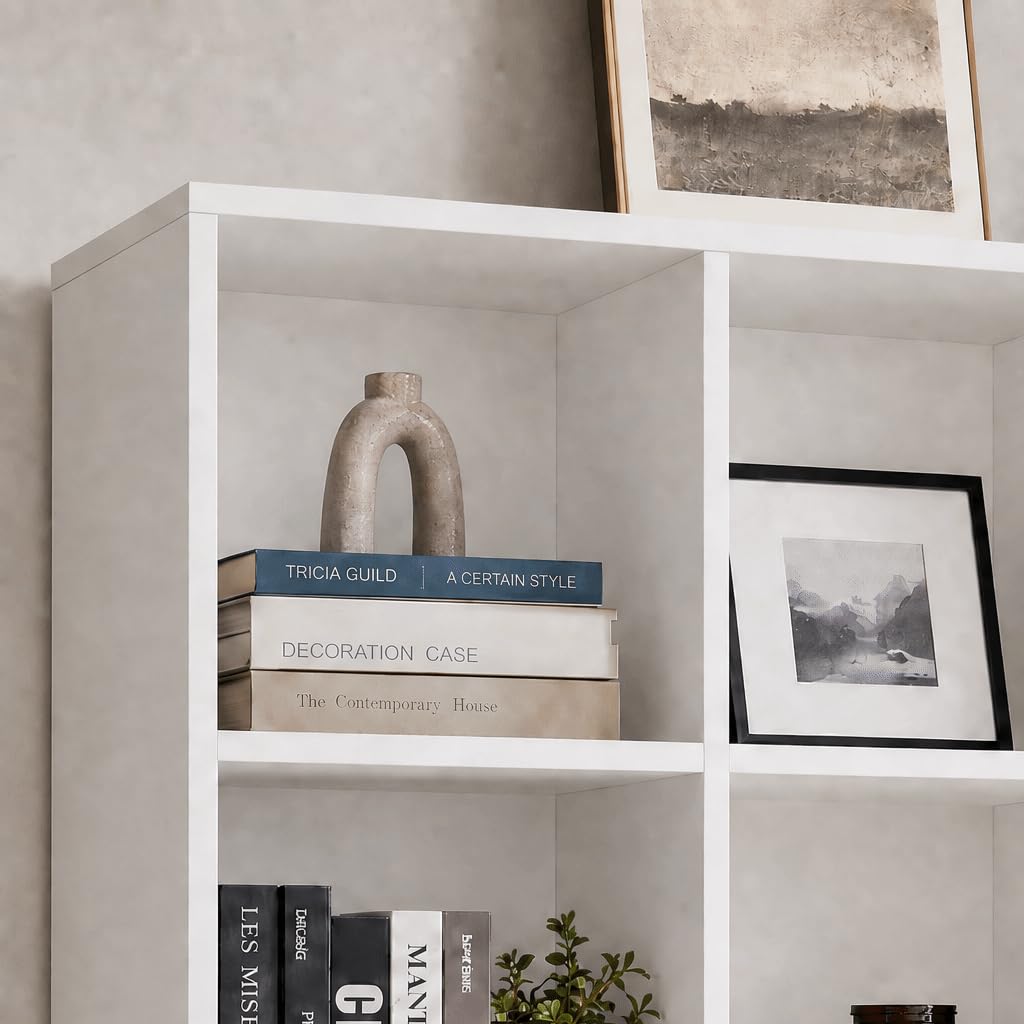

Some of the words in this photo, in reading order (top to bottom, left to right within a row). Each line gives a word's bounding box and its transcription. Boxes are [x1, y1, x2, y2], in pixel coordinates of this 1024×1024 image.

[285, 564, 341, 581] TRICIA
[346, 567, 397, 583] GUILD
[446, 571, 457, 585] A
[462, 572, 525, 587] CERTAIN
[530, 575, 577, 589] STYLE
[281, 641, 414, 662] DECORATION
[425, 646, 478, 663] CASE
[297, 693, 326, 708] The
[335, 695, 440, 715] Contemporary
[453, 697, 498, 713] House
[240, 907, 259, 954] LES
